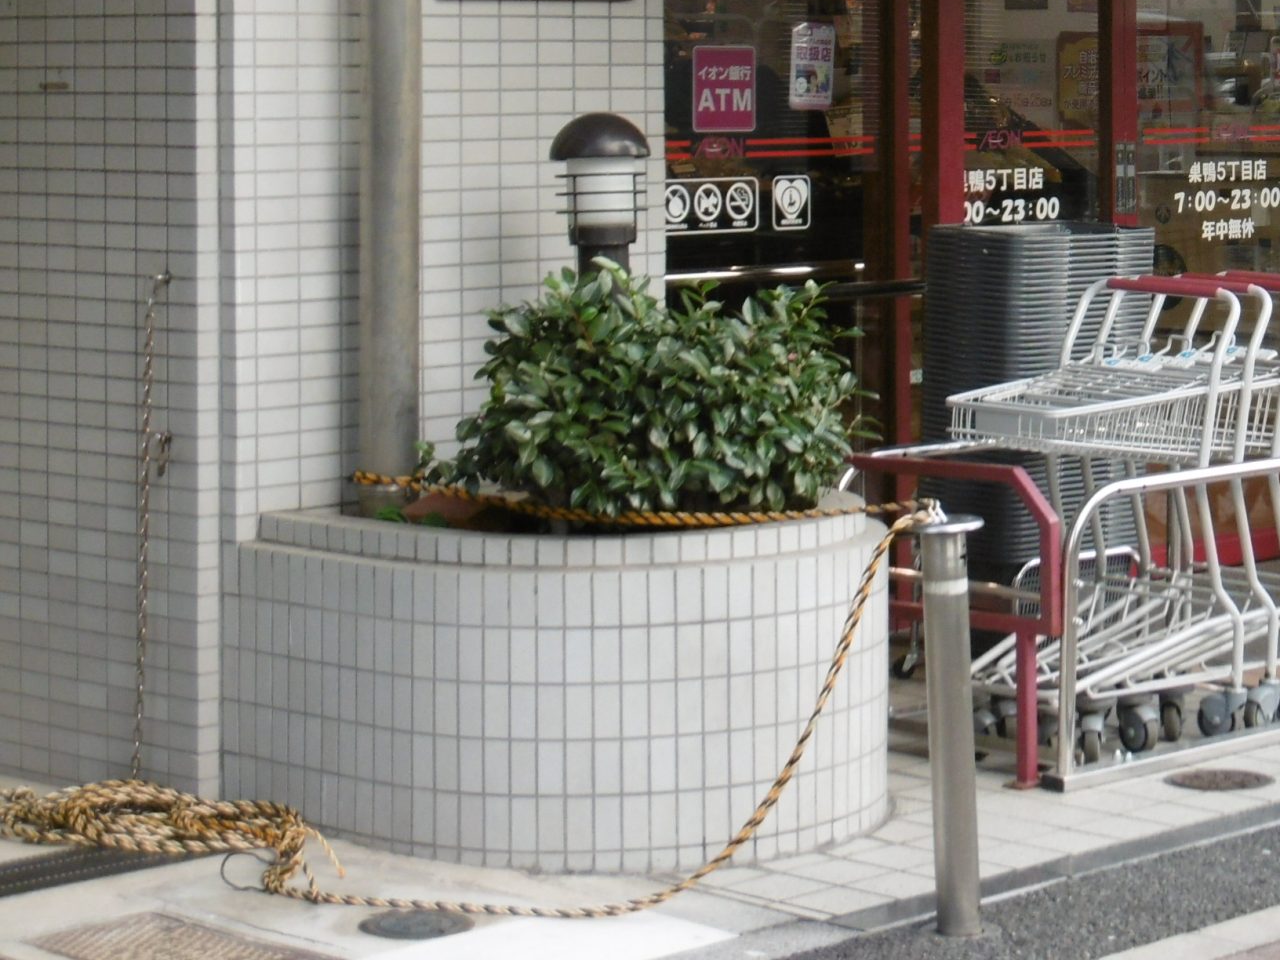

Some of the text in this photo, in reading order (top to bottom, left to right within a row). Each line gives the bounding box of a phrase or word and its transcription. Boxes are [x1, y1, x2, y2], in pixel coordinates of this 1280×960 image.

[697, 65, 752, 81] イオン銀行
[698, 88, 752, 112] ATM
[1189, 159, 1267, 183] 巣鴨5丁目店
[1202, 217, 1254, 241] 年中無休
